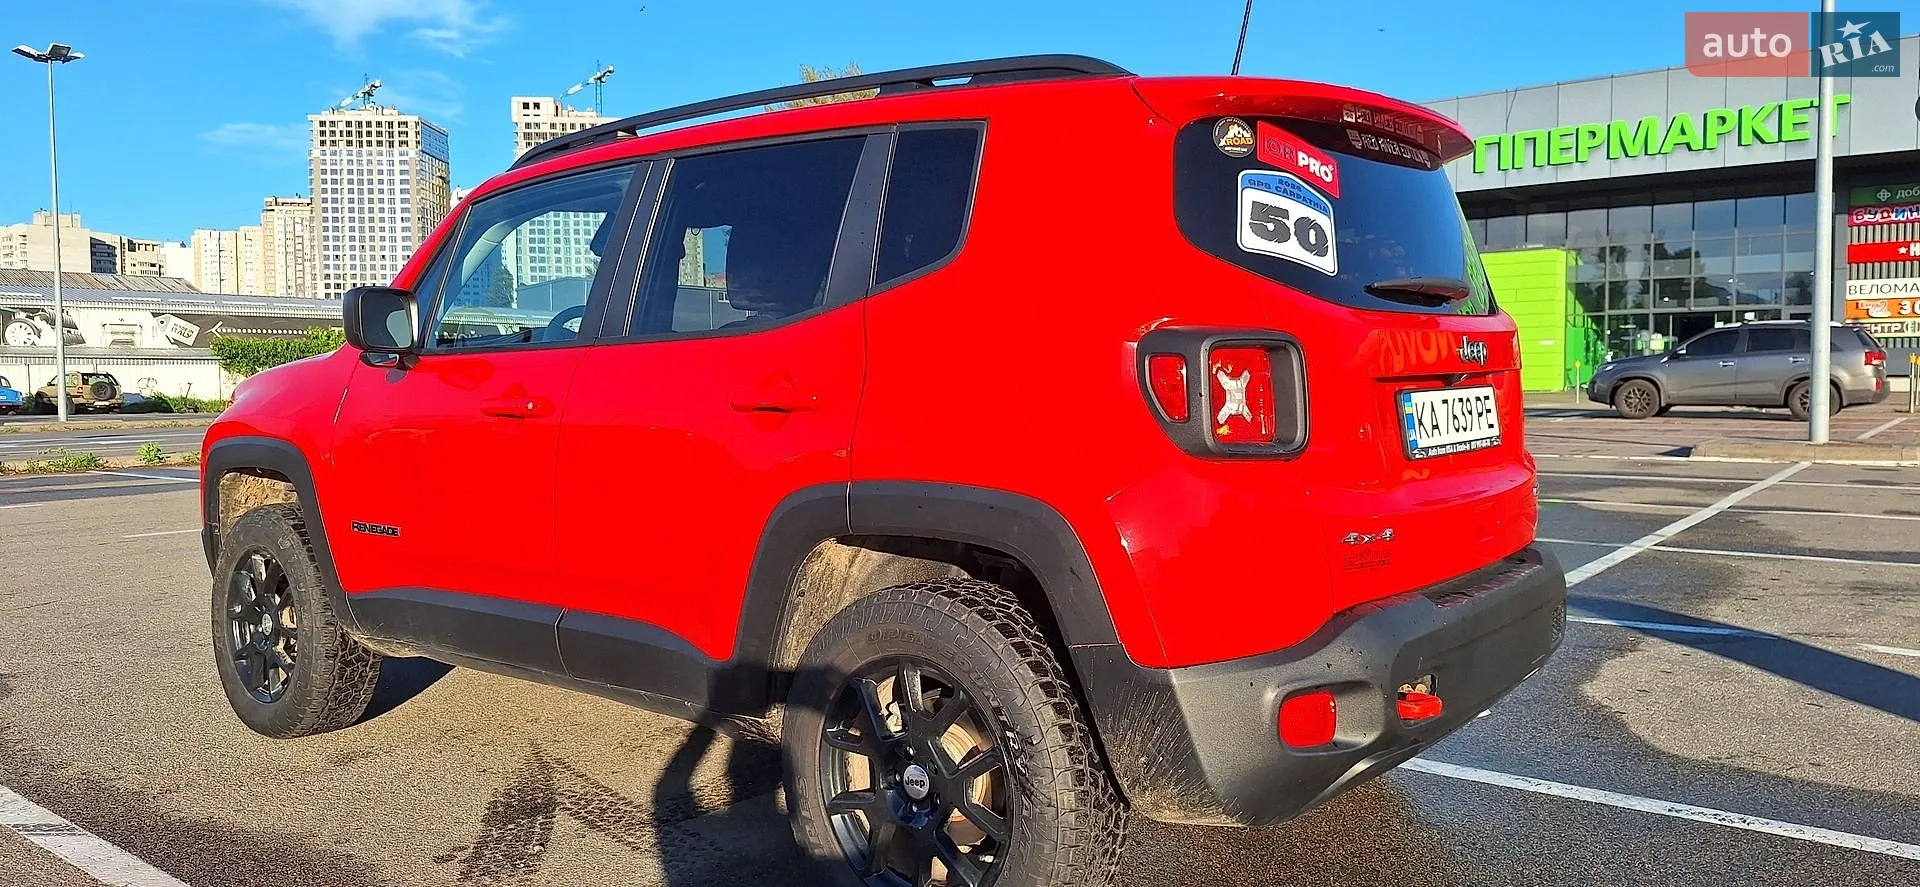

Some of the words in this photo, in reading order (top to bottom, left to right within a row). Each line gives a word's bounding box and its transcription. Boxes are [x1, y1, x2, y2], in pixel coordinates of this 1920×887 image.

[1456, 335, 1487, 366] Jeep
[1415, 400, 1442, 440] KA
[1441, 397, 1474, 435] 7639
[1475, 395, 1495, 431] PE
[351, 520, 401, 537] RENEGADE
[904, 775, 926, 789] Jeep
